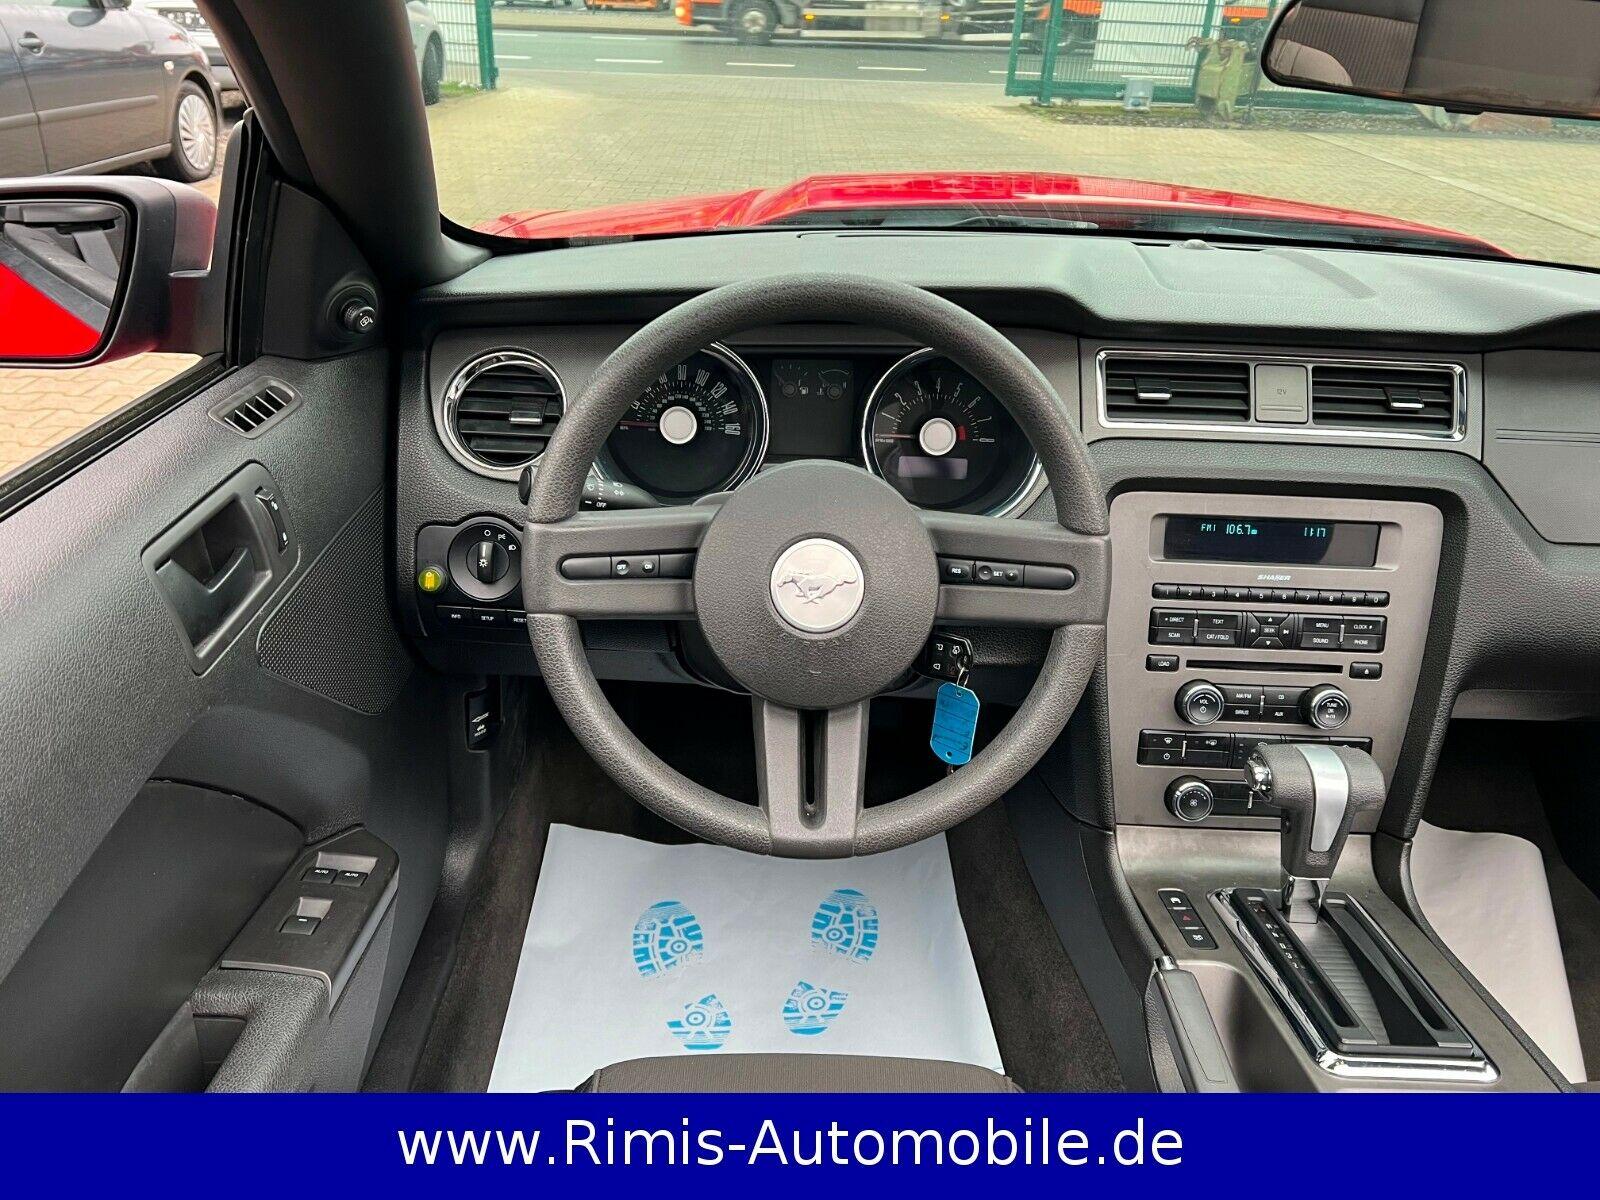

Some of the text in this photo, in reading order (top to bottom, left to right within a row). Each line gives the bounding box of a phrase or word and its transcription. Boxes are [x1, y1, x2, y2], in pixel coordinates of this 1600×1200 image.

[677, 364, 687, 381] 80
[695, 369, 710, 387] 100
[711, 382, 728, 399] 120
[723, 400, 738, 415] 140
[725, 423, 741, 436] 160
[1226, 524, 1250, 535] 106.7
